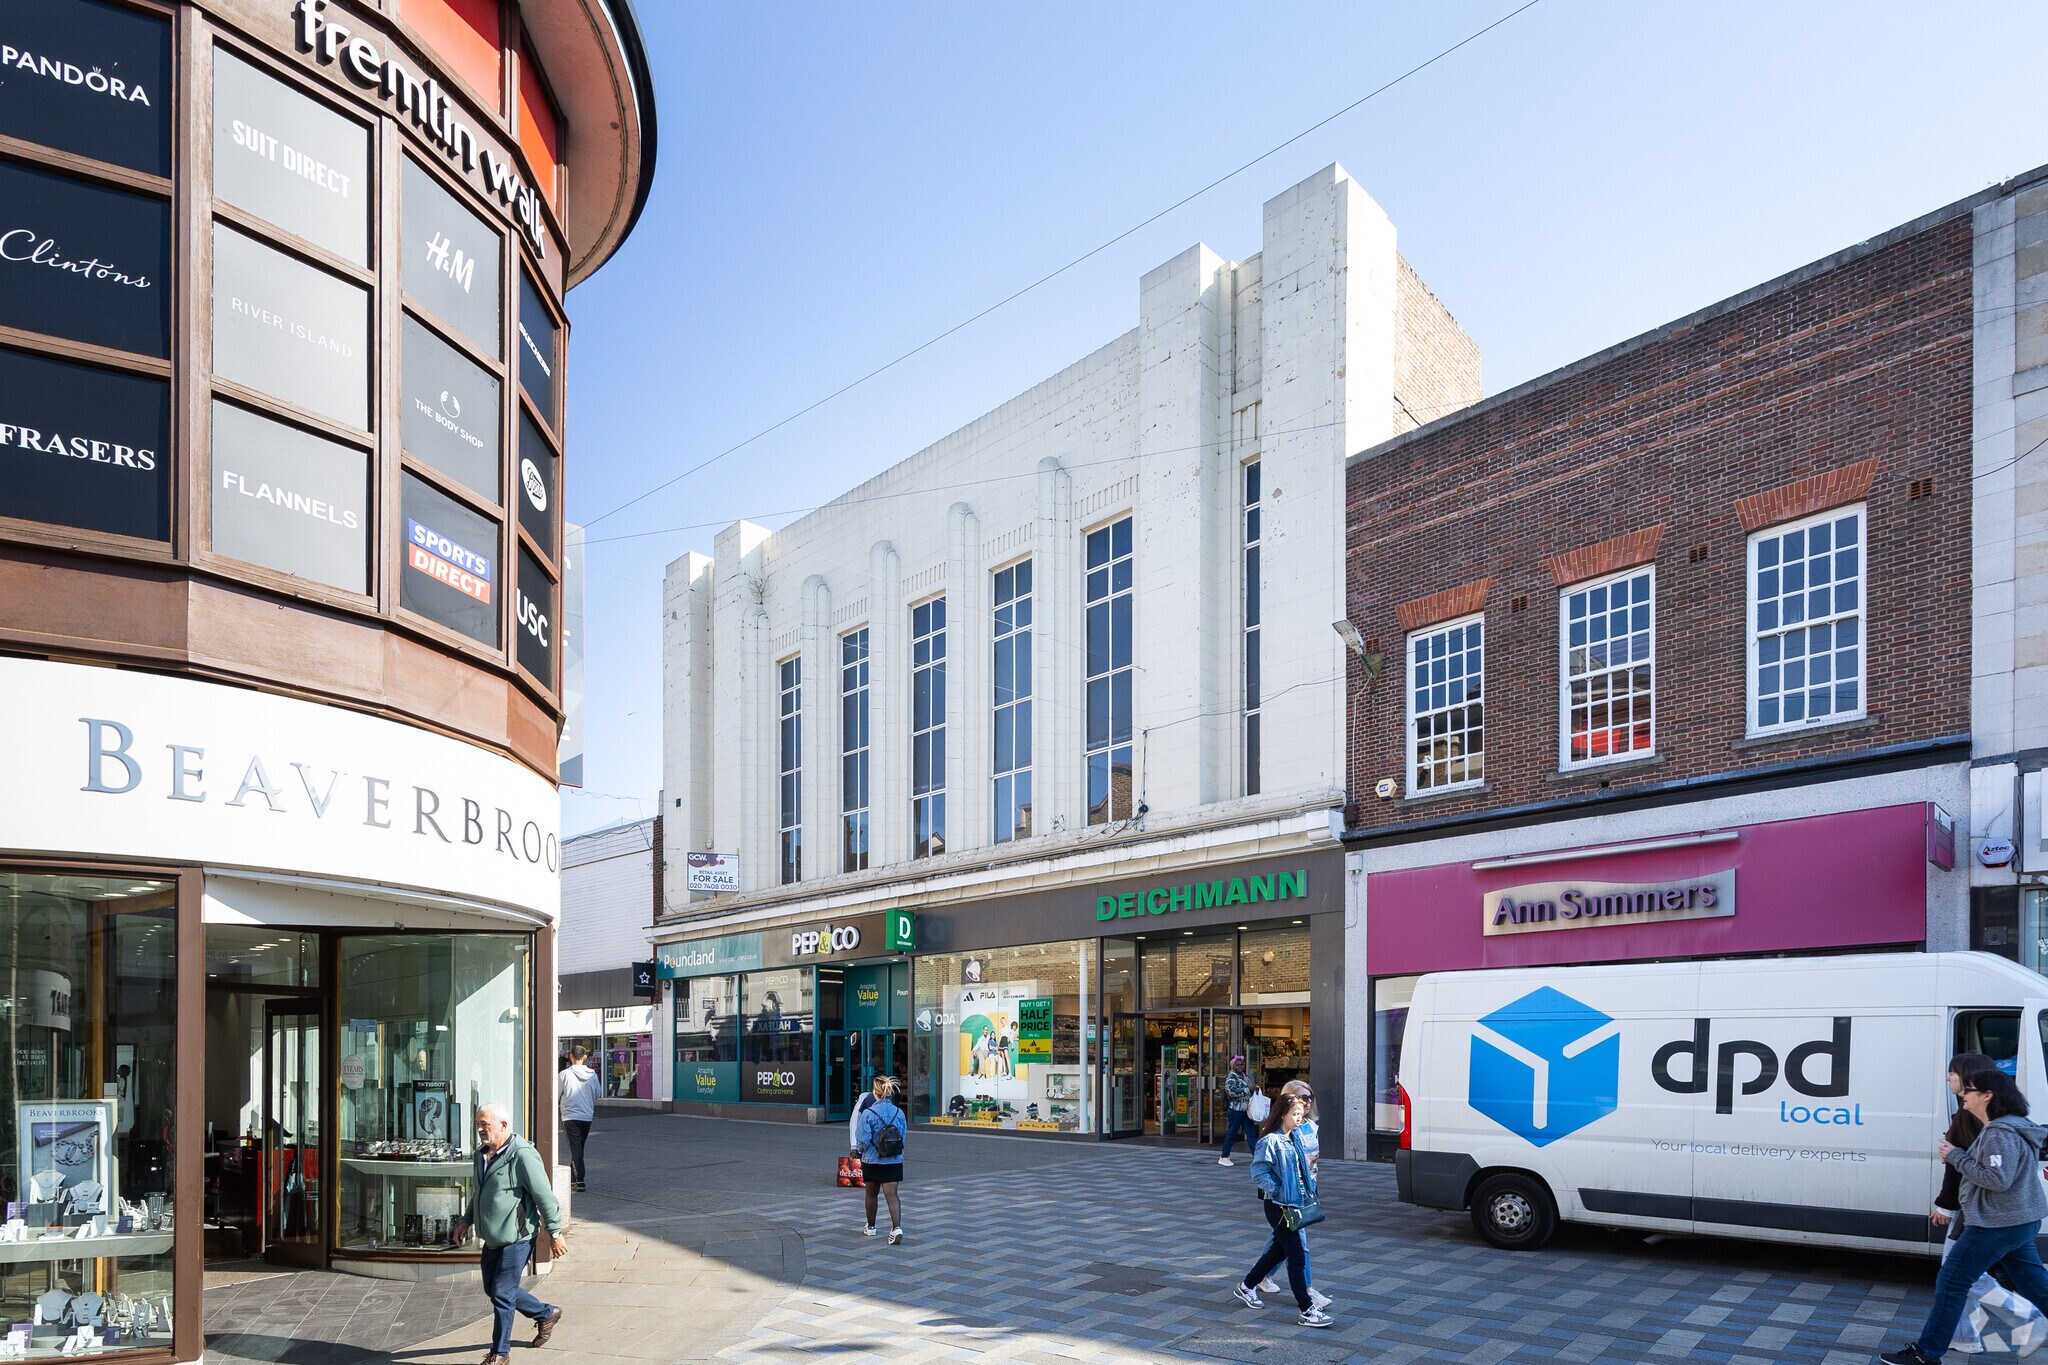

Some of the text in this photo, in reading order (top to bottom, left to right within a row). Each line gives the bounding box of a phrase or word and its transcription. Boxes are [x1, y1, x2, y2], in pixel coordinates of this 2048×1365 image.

[2, 44, 151, 107] PANDORA
[296, 0, 546, 260] fremlin walk
[232, 119, 351, 199] SUIT DIRECT
[0, 229, 151, 288] Clintons
[425, 231, 475, 294] H&M
[232, 296, 352, 358] RIVER ISLAND
[415, 398, 484, 449] THE BODY SHOP
[0, 422, 156, 472] FRASERS
[222, 470, 358, 530] FLANNELS
[413, 524, 486, 576] SPORTS
[414, 549, 486, 598] DIRECT
[516, 587, 549, 648] USC
[78, 717, 560, 878] BEAVERBROO
[1984, 844, 2010, 853] Aztec
[693, 874, 734, 884] FOR SALE
[1096, 868, 1308, 921] DEICHMANN
[1492, 883, 1718, 926] Ann Summers
[899, 916, 911, 939] D
[664, 947, 715, 969] Poundland
[857, 989, 879, 1000] Value
[859, 983, 877, 991] Amazing
[980, 991, 996, 999] FILA
[1020, 1009, 1050, 1020] HALF
[1020, 1021, 1050, 1032] PRICE
[346, 1065, 364, 1073] YEARS
[695, 1074, 717, 1086] Value
[697, 1067, 714, 1076] Amazing
[1651, 1016, 1852, 1115] dpd
[756, 1087, 773, 1096] Clothing
[29, 1108, 104, 1117] BEAVERBROOKS
[1780, 1100, 1864, 1126] local
[1651, 1139, 1867, 1162] Your local delivery experts
